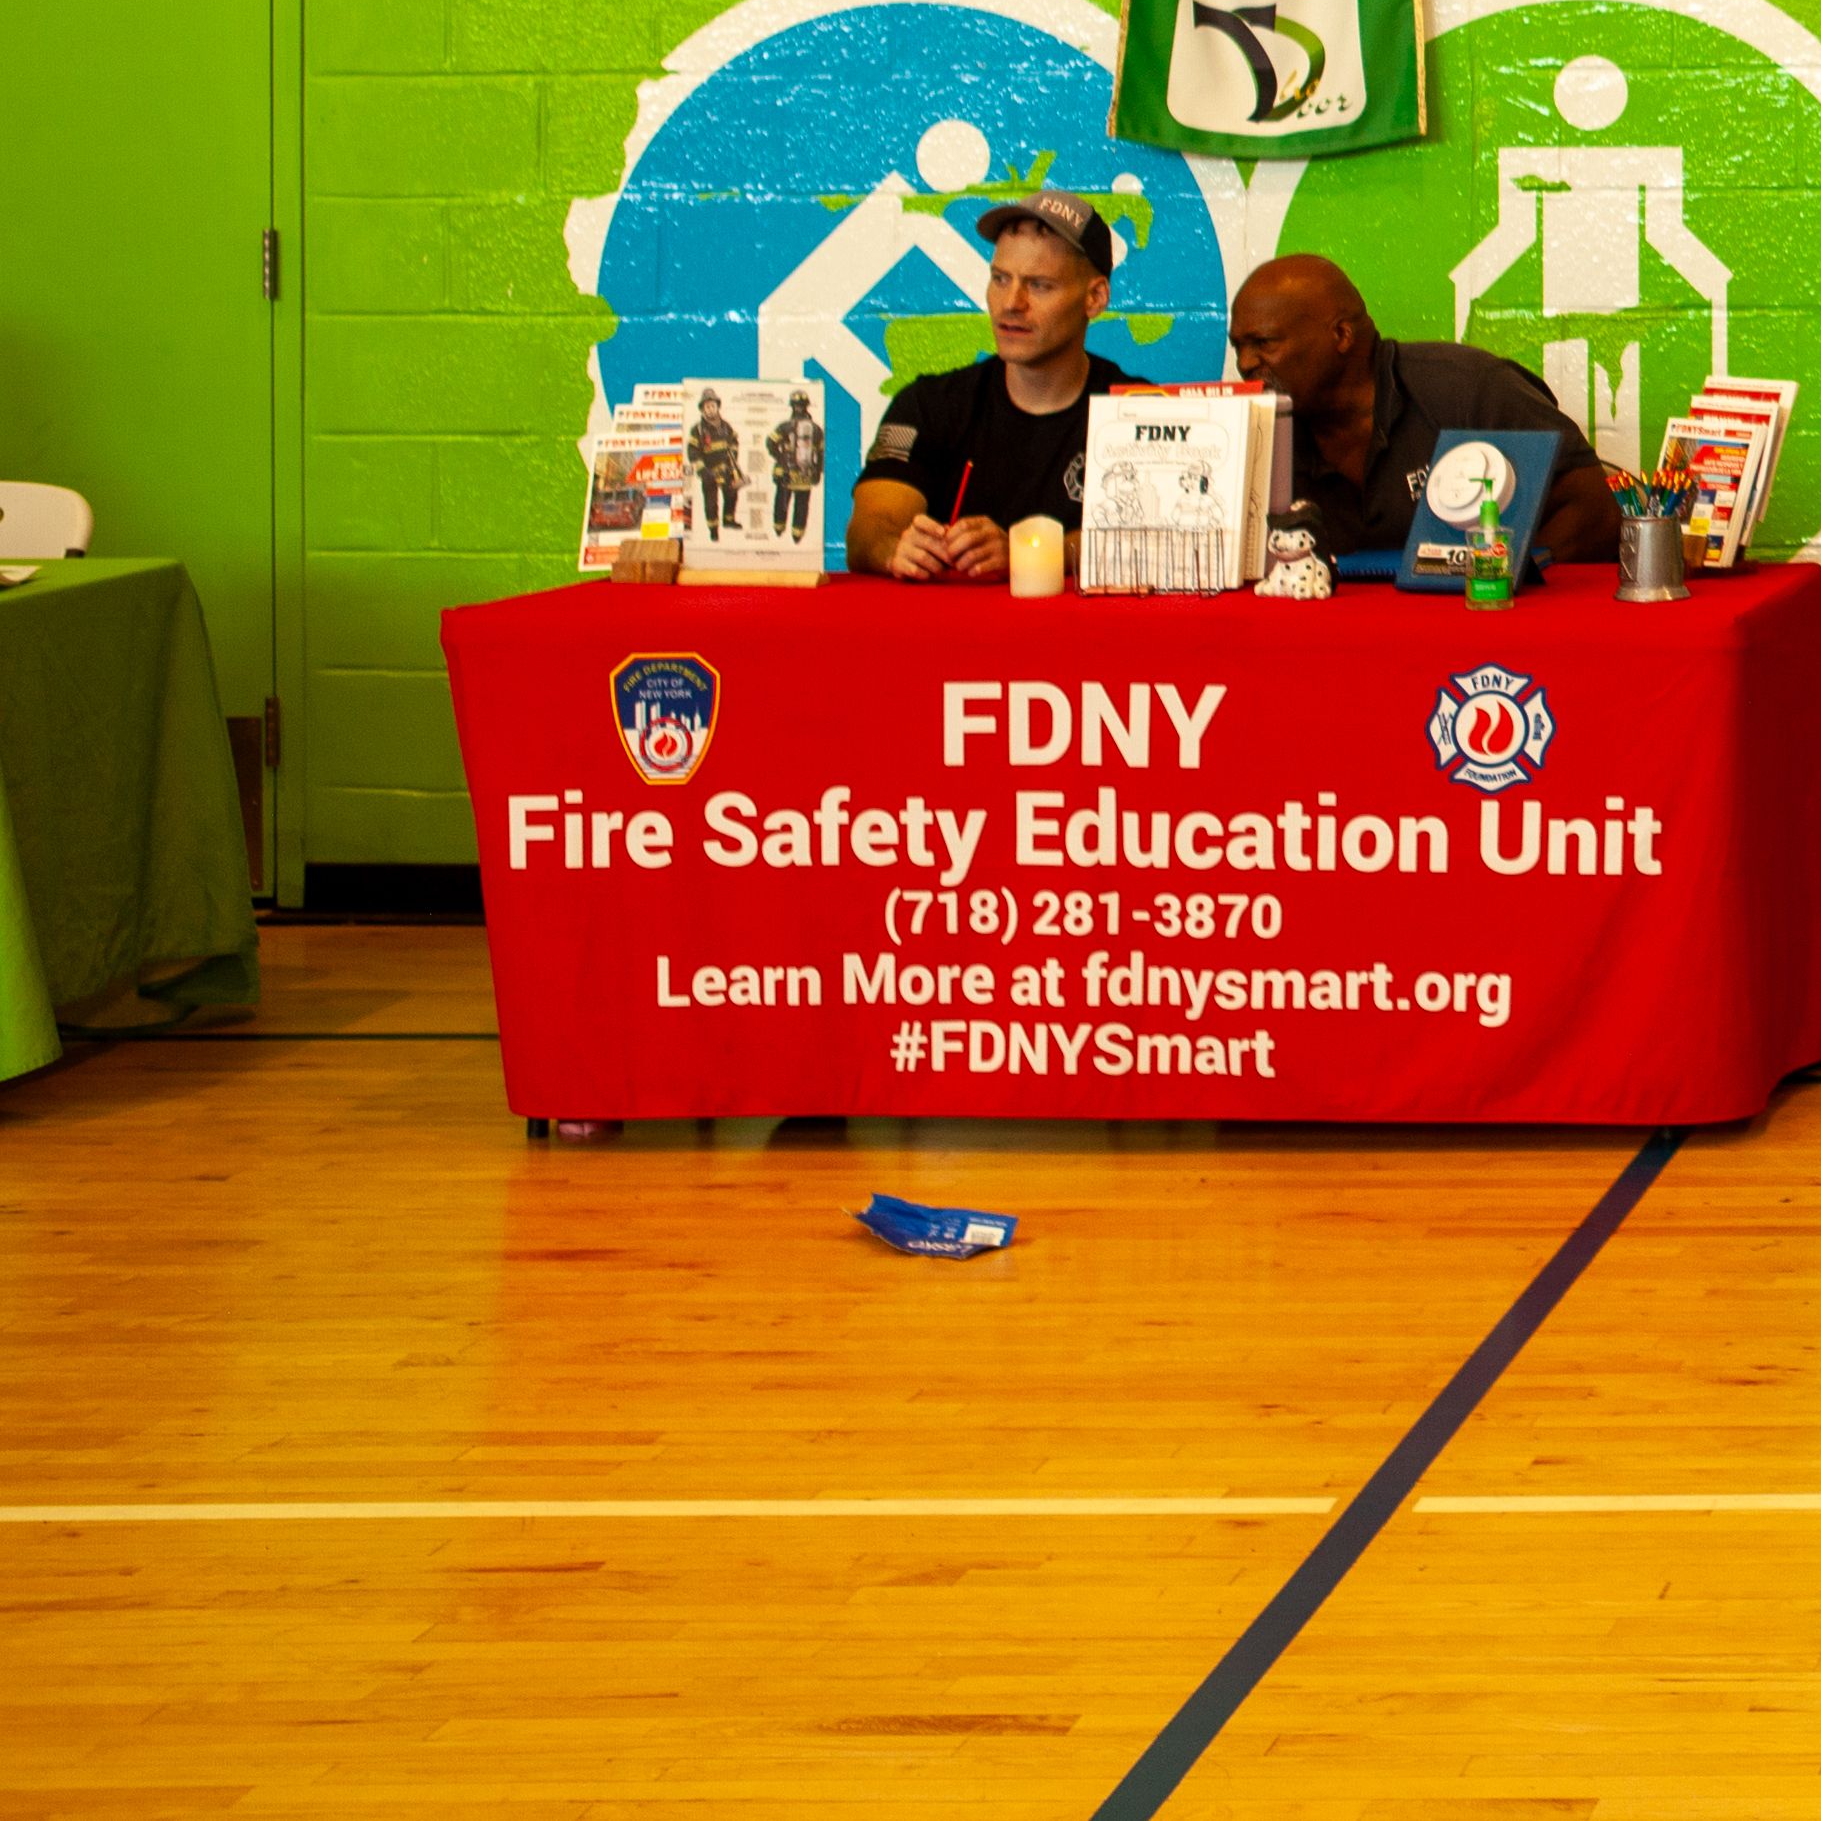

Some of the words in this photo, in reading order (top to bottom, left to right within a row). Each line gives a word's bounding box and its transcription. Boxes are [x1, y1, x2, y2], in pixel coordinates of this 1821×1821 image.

[1135, 424, 1191, 442] FDNY
[1470, 674, 1515, 691] FDNY
[942, 681, 1228, 770] FDNY
[507, 790, 675, 872] Fire
[703, 786, 988, 888] Safety
[1015, 786, 1451, 874] Education
[1479, 796, 1664, 877] Unit
[883, 889, 1020, 946] (718)
[1031, 890, 1285, 940] 281-3870
[655, 956, 823, 1009] Learn
[842, 952, 995, 1007] More
[1010, 958, 1067, 1010] at
[1081, 951, 1514, 1028] fdnysmart.org
[890, 1020, 1277, 1079] #FDNYSmart
